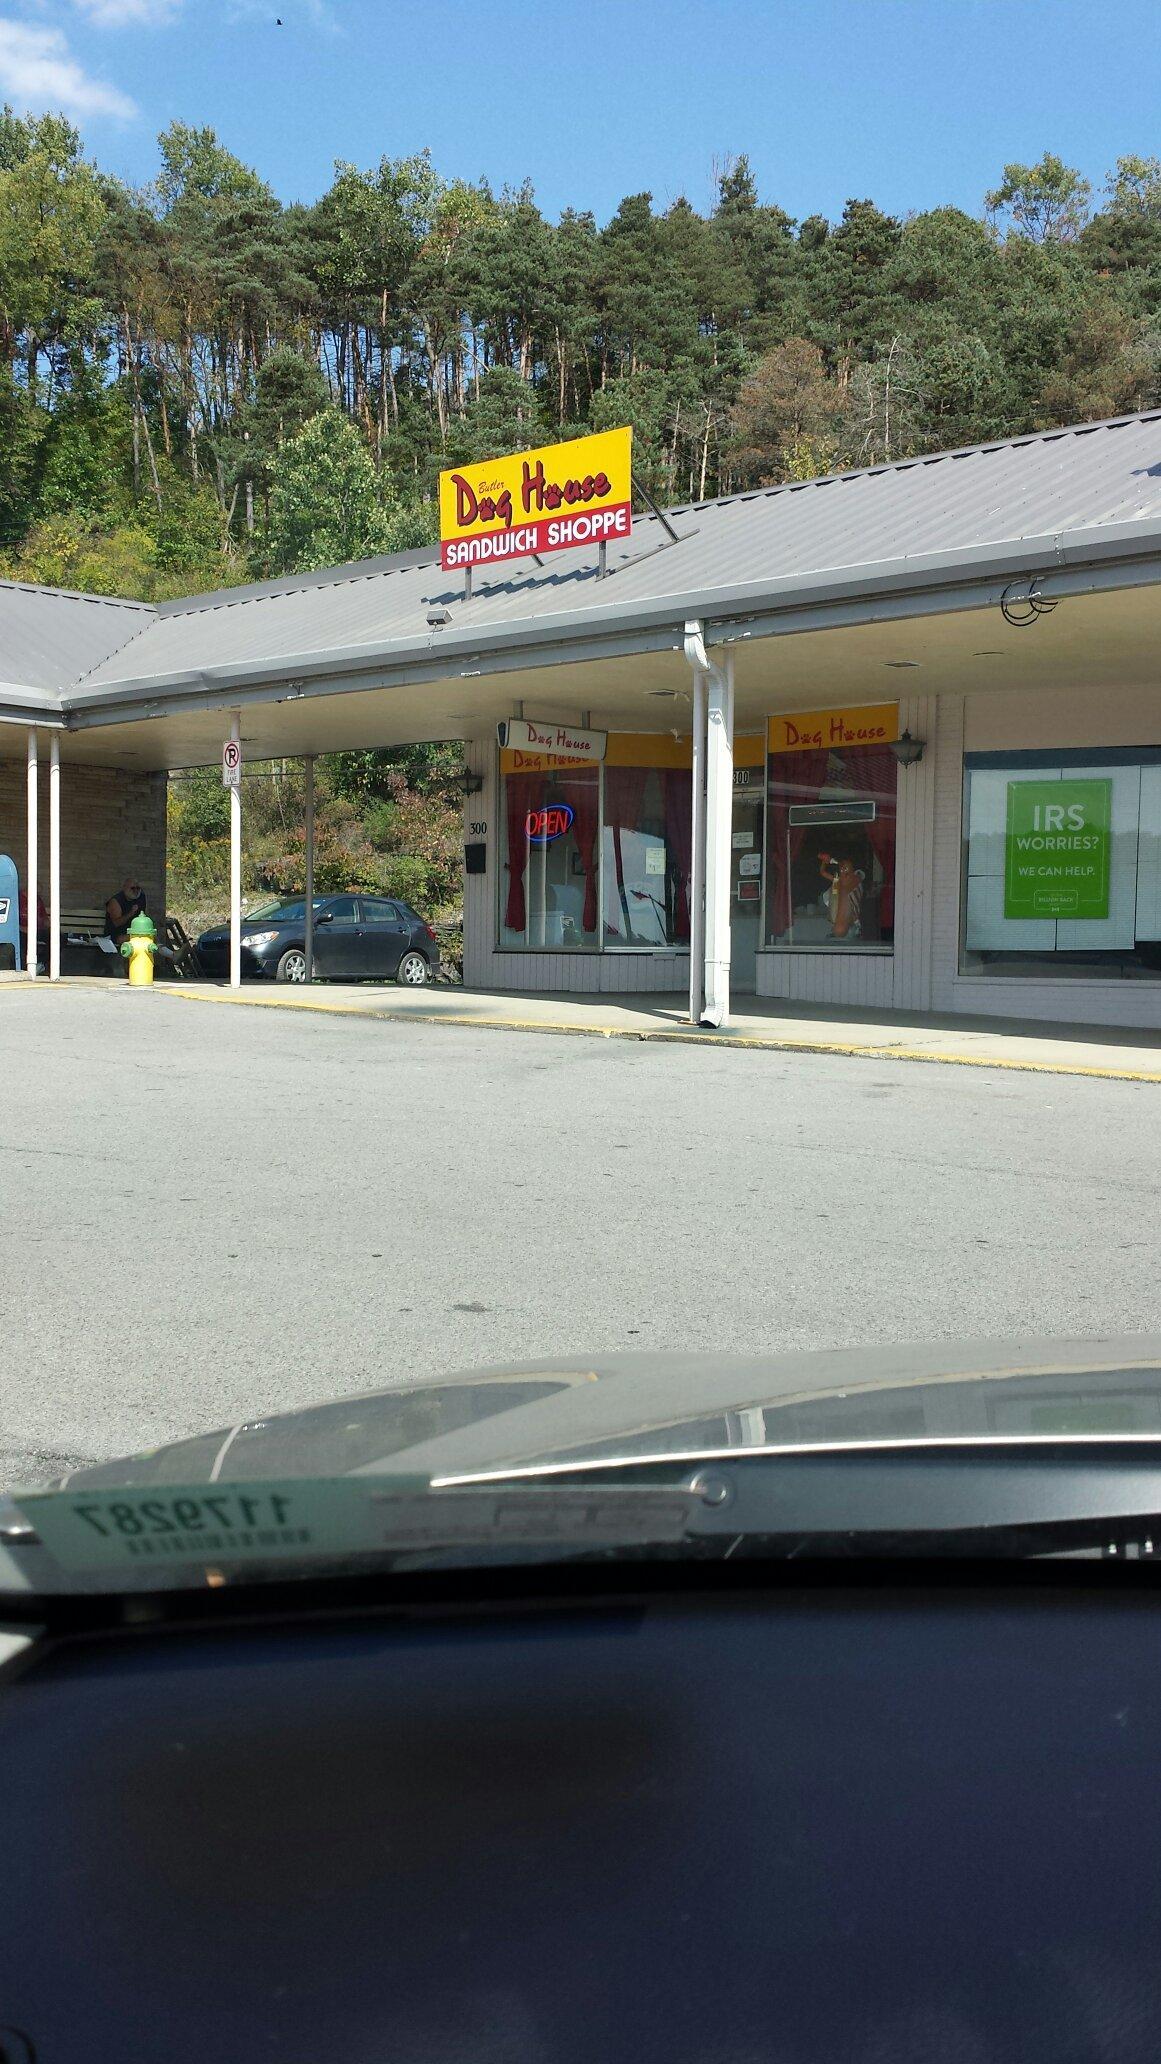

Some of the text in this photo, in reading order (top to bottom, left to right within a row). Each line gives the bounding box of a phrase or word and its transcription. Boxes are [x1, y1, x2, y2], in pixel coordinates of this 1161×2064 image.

[450, 460, 612, 529] Dog House
[478, 479, 505, 494] Butler
[446, 508, 627, 565] SANDWICH SHOPPE
[526, 723, 592, 750] Dog House
[783, 717, 887, 749] Dog House
[469, 821, 487, 835] 300
[525, 810, 568, 836] OPEN
[1033, 804, 1086, 832] IRS
[1016, 836, 1100, 851] WORRIES?
[1018, 865, 1096, 877] WE CAN HELP.
